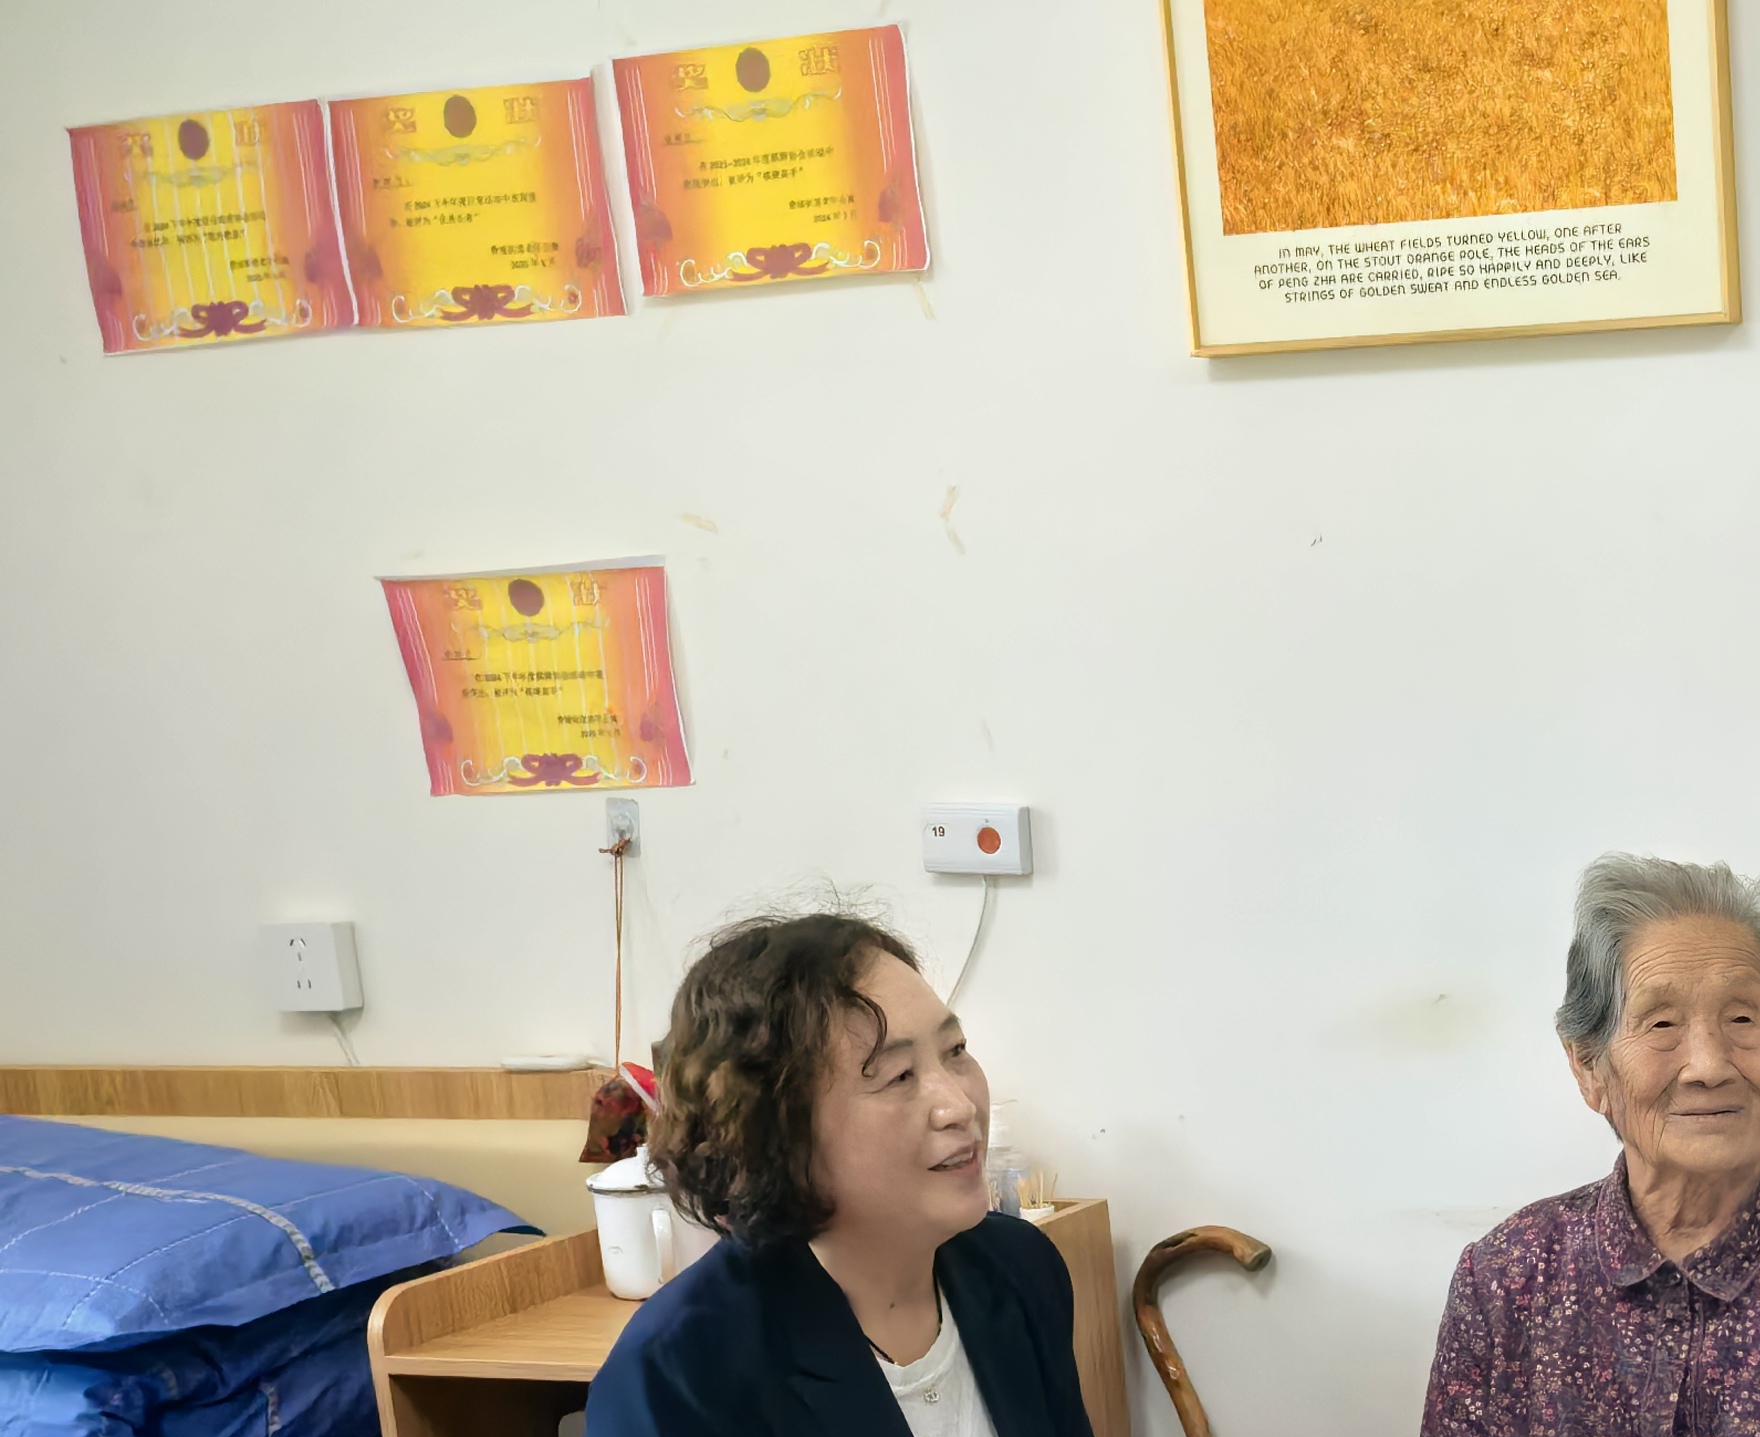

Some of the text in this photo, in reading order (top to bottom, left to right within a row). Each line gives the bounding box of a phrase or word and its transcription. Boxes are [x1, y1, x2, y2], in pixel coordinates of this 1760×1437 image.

[1279, 249, 1291, 259] IN
[1328, 243, 1350, 255] THE
[1355, 240, 1394, 253] WHEAT
[1401, 237, 1441, 250] FIELDS
[1447, 233, 1493, 246] TURNED
[1554, 227, 1578, 238] ONE
[1583, 223, 1621, 235] AFTER
[1317, 260, 1333, 271] ON
[1338, 258, 1359, 269] THE
[1364, 255, 1401, 267] STOUT
[1407, 251, 1454, 265] ORANGE
[1497, 246, 1520, 258] THE
[1526, 243, 1565, 256] HEADS
[1570, 241, 1586, 252] OF
[1590, 239, 1613, 251] THE
[1619, 236, 1650, 249] EARS
[1259, 279, 1273, 289] OF
[1278, 277, 1308, 288] PENG
[1314, 275, 1336, 286] ZHA
[1341, 273, 1363, 284] ARE
[1427, 266, 1454, 277] RIPE
[1459, 265, 1474, 276] SO
[1479, 261, 1531, 274] HAPPILY
[1536, 259, 1561, 269] AND
[1620, 252, 1647, 264] LIKE
[1285, 290, 1335, 303] STRINGS
[1340, 289, 1353, 299] OF
[1360, 285, 1406, 297] GOLDEN
[1410, 282, 1448, 294] SWEAT
[1455, 280, 1479, 291] AND
[1484, 275, 1537, 289] ENDLESS
[1542, 272, 1589, 285] GOLDEN
[931, 825, 946, 838] 19
